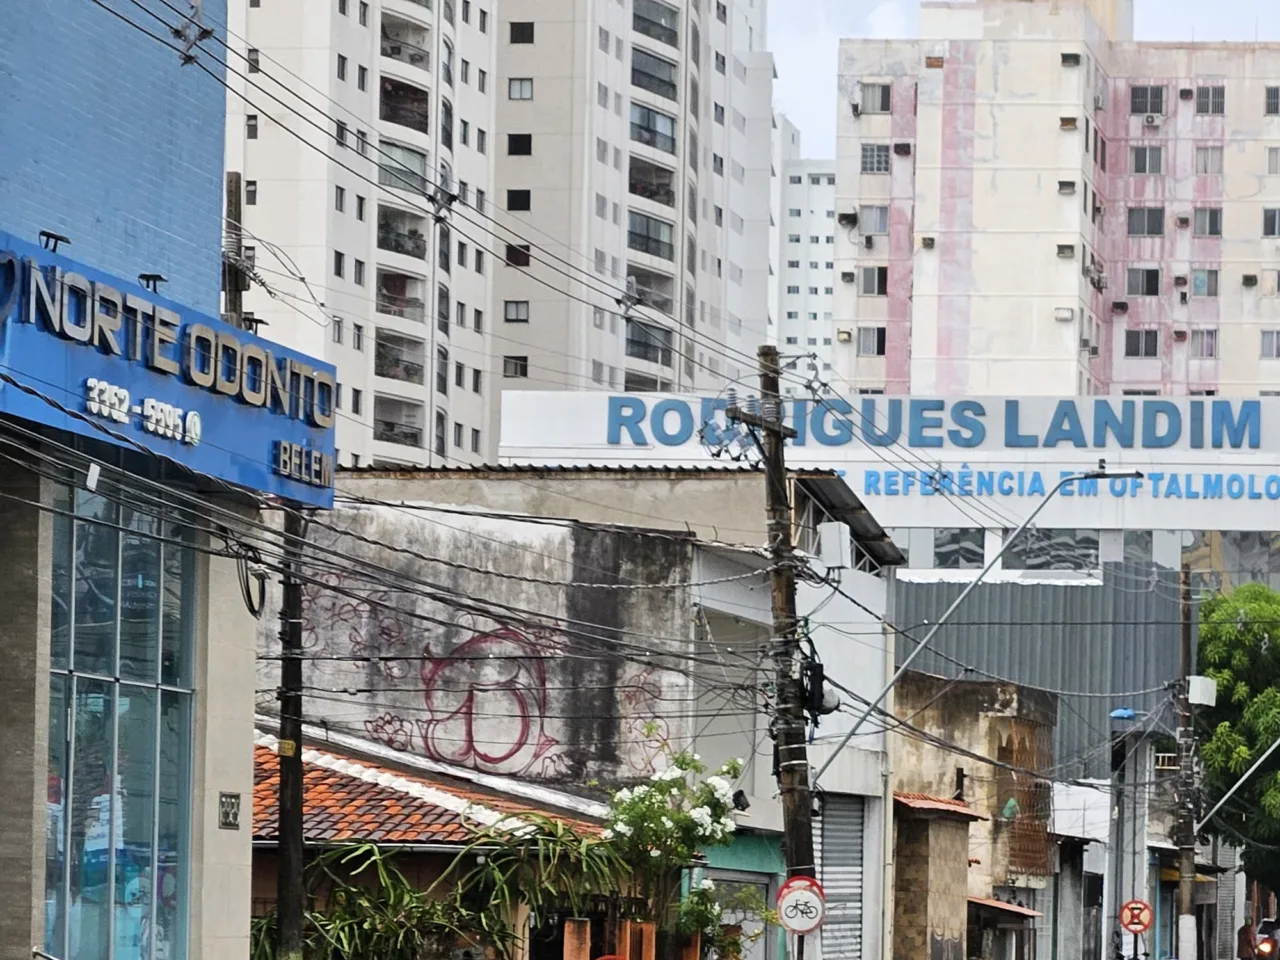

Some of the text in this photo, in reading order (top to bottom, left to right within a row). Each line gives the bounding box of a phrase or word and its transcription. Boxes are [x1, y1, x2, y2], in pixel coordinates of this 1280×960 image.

[27, 258, 334, 429] NORTE ODONTO
[606, 396, 1261, 449] RODIGUES LANDIM
[864, 463, 1046, 497] REFERÊNCIA
[1059, 471, 1098, 497] EM
